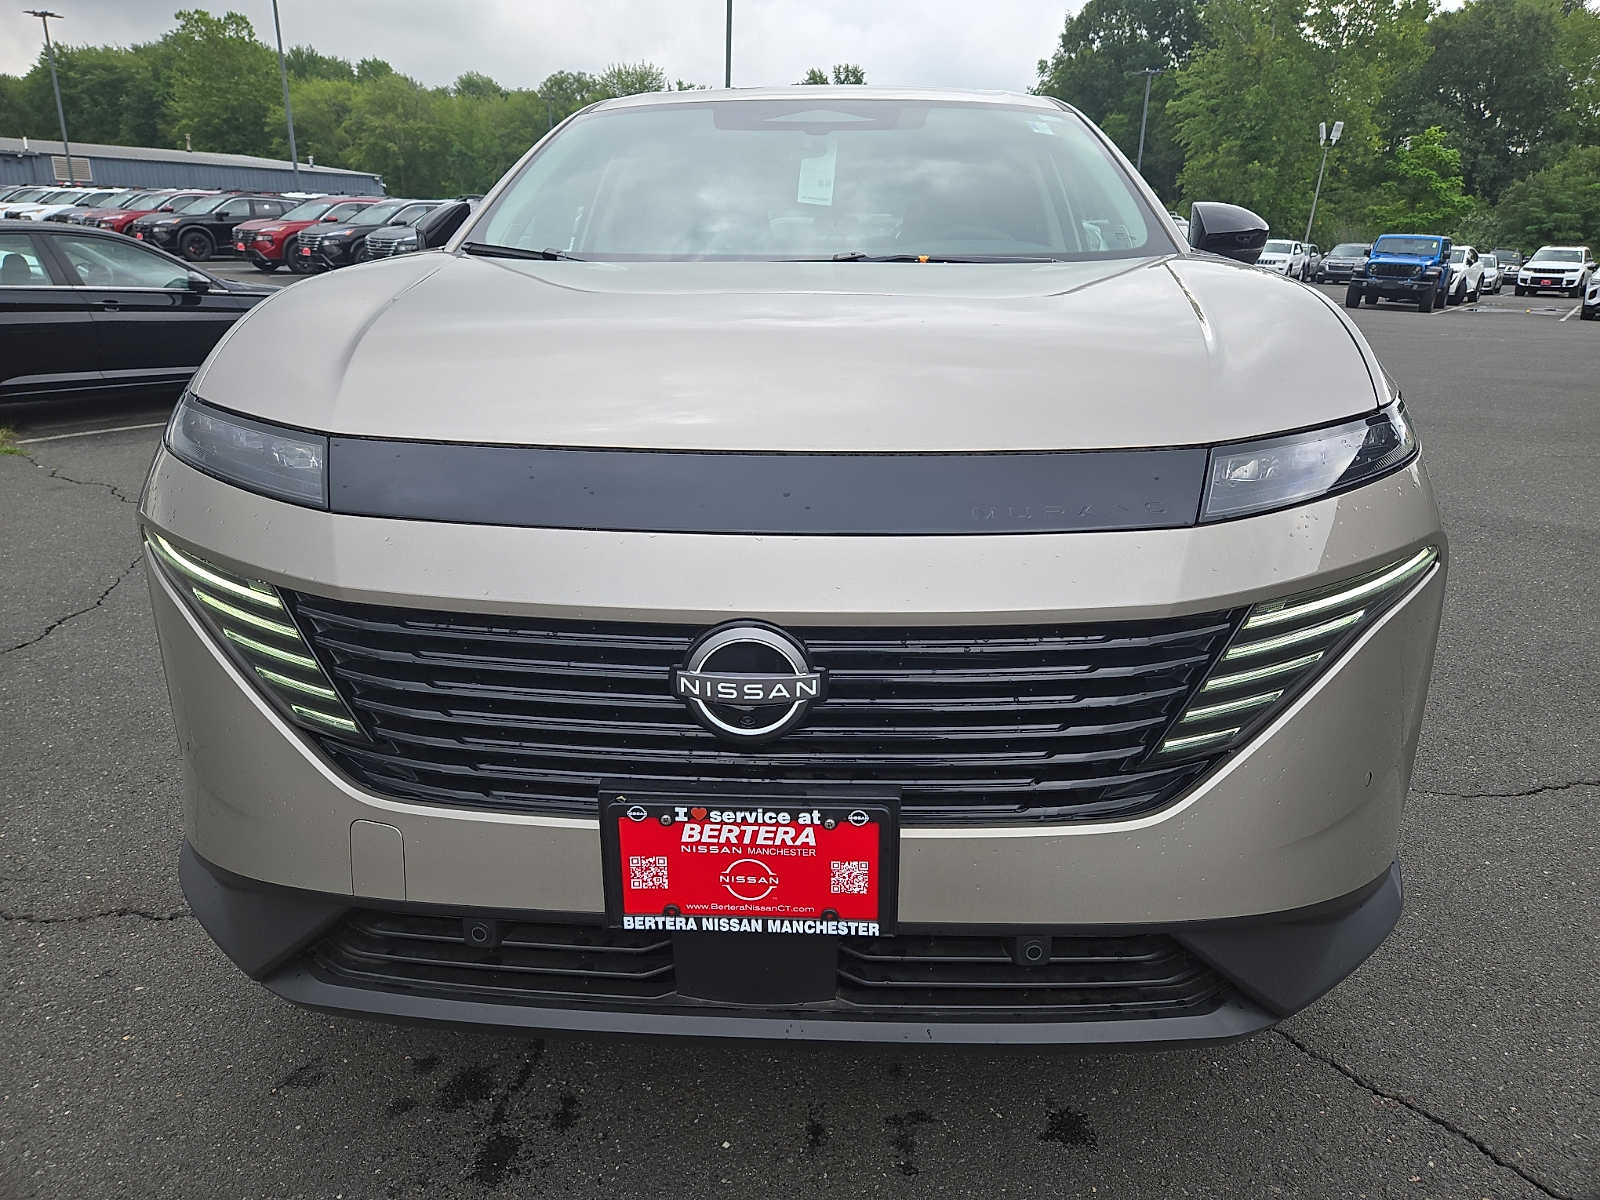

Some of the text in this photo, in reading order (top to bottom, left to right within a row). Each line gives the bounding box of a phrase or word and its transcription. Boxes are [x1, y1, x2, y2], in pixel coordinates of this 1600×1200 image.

[680, 677, 817, 700] NISSAN
[674, 807, 821, 824] I service at
[681, 823, 816, 846] BERTERA
[681, 845, 816, 856] NISSAN MANCHESTER
[720, 875, 779, 885] NISSAN
[686, 903, 815, 913] www.BerteraNissanCT.com
[623, 916, 880, 936] BERTERA NISSAN MANCHESTER
